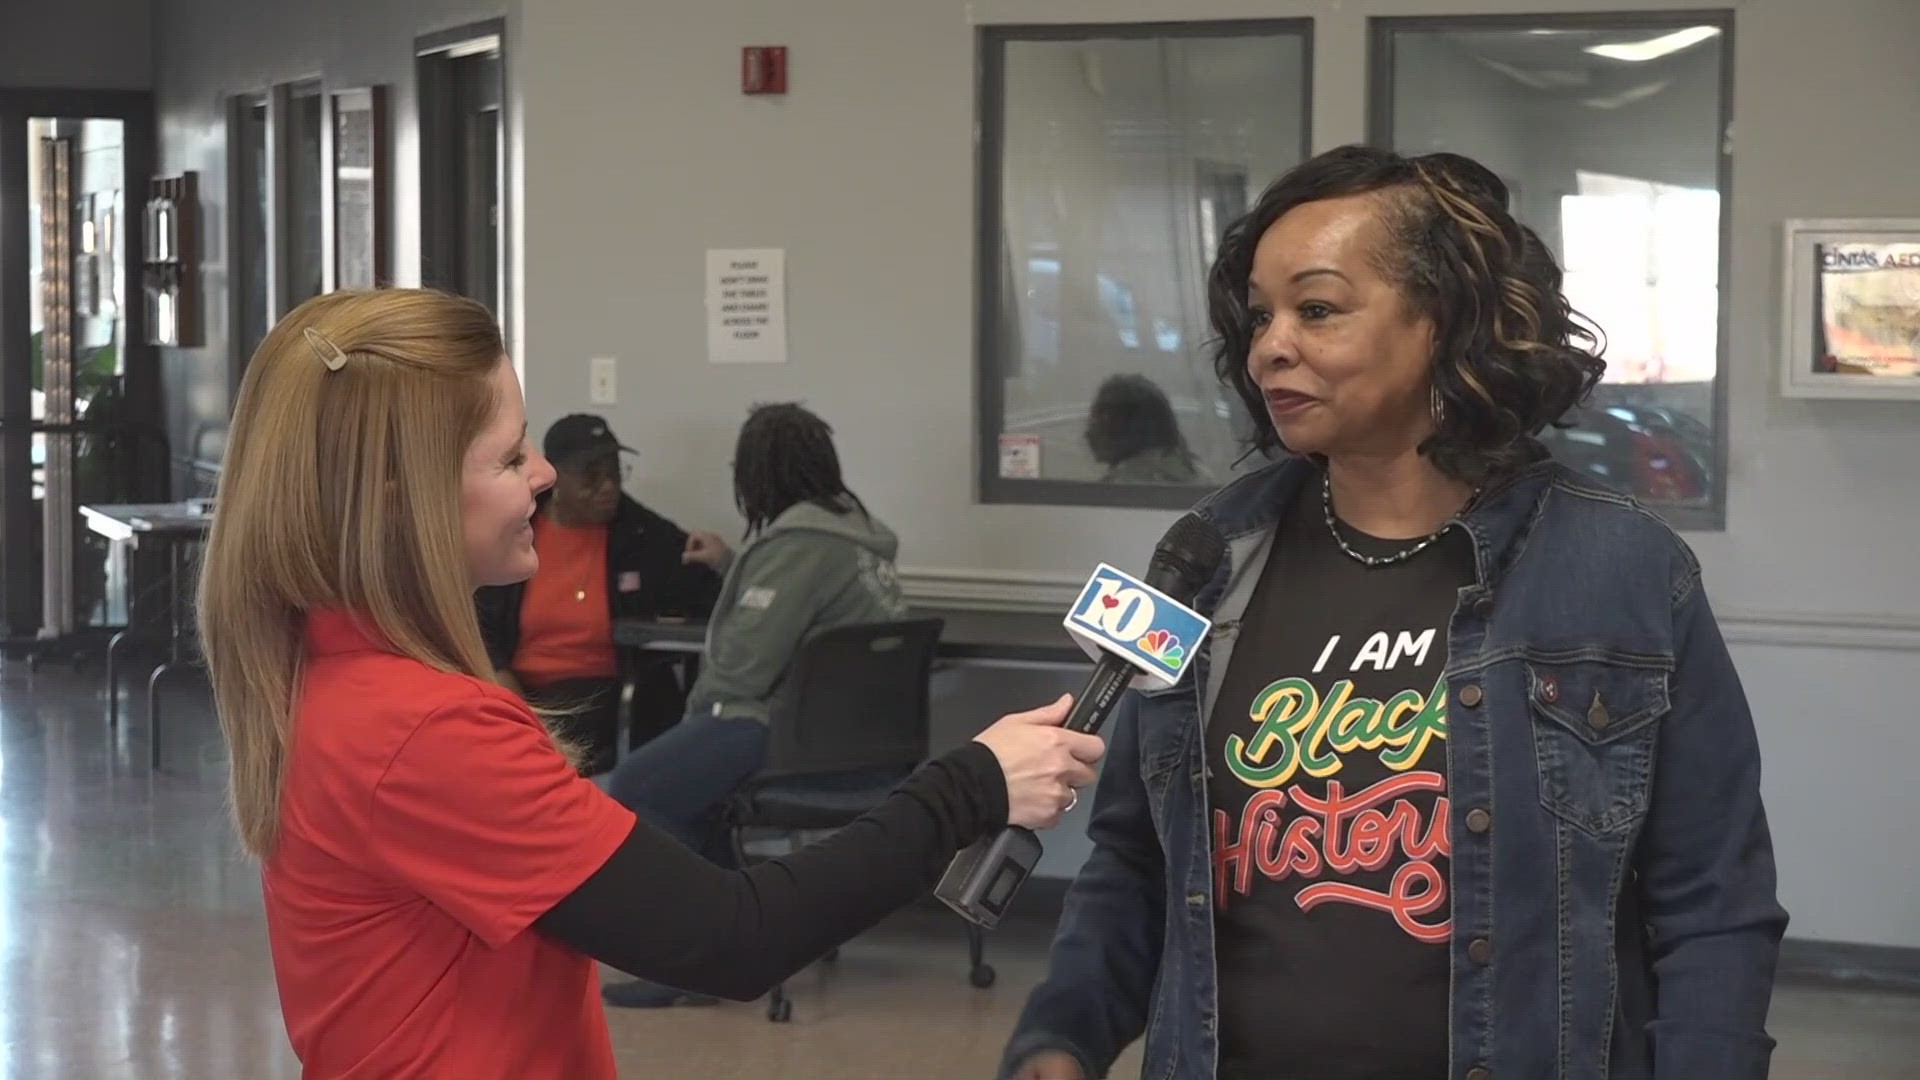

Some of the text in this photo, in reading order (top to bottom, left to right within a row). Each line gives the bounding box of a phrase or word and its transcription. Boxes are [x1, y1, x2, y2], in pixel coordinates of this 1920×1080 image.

[1073, 577, 1155, 642] 10
[1312, 628, 1436, 673] I AM
[1224, 671, 1449, 788] Black
